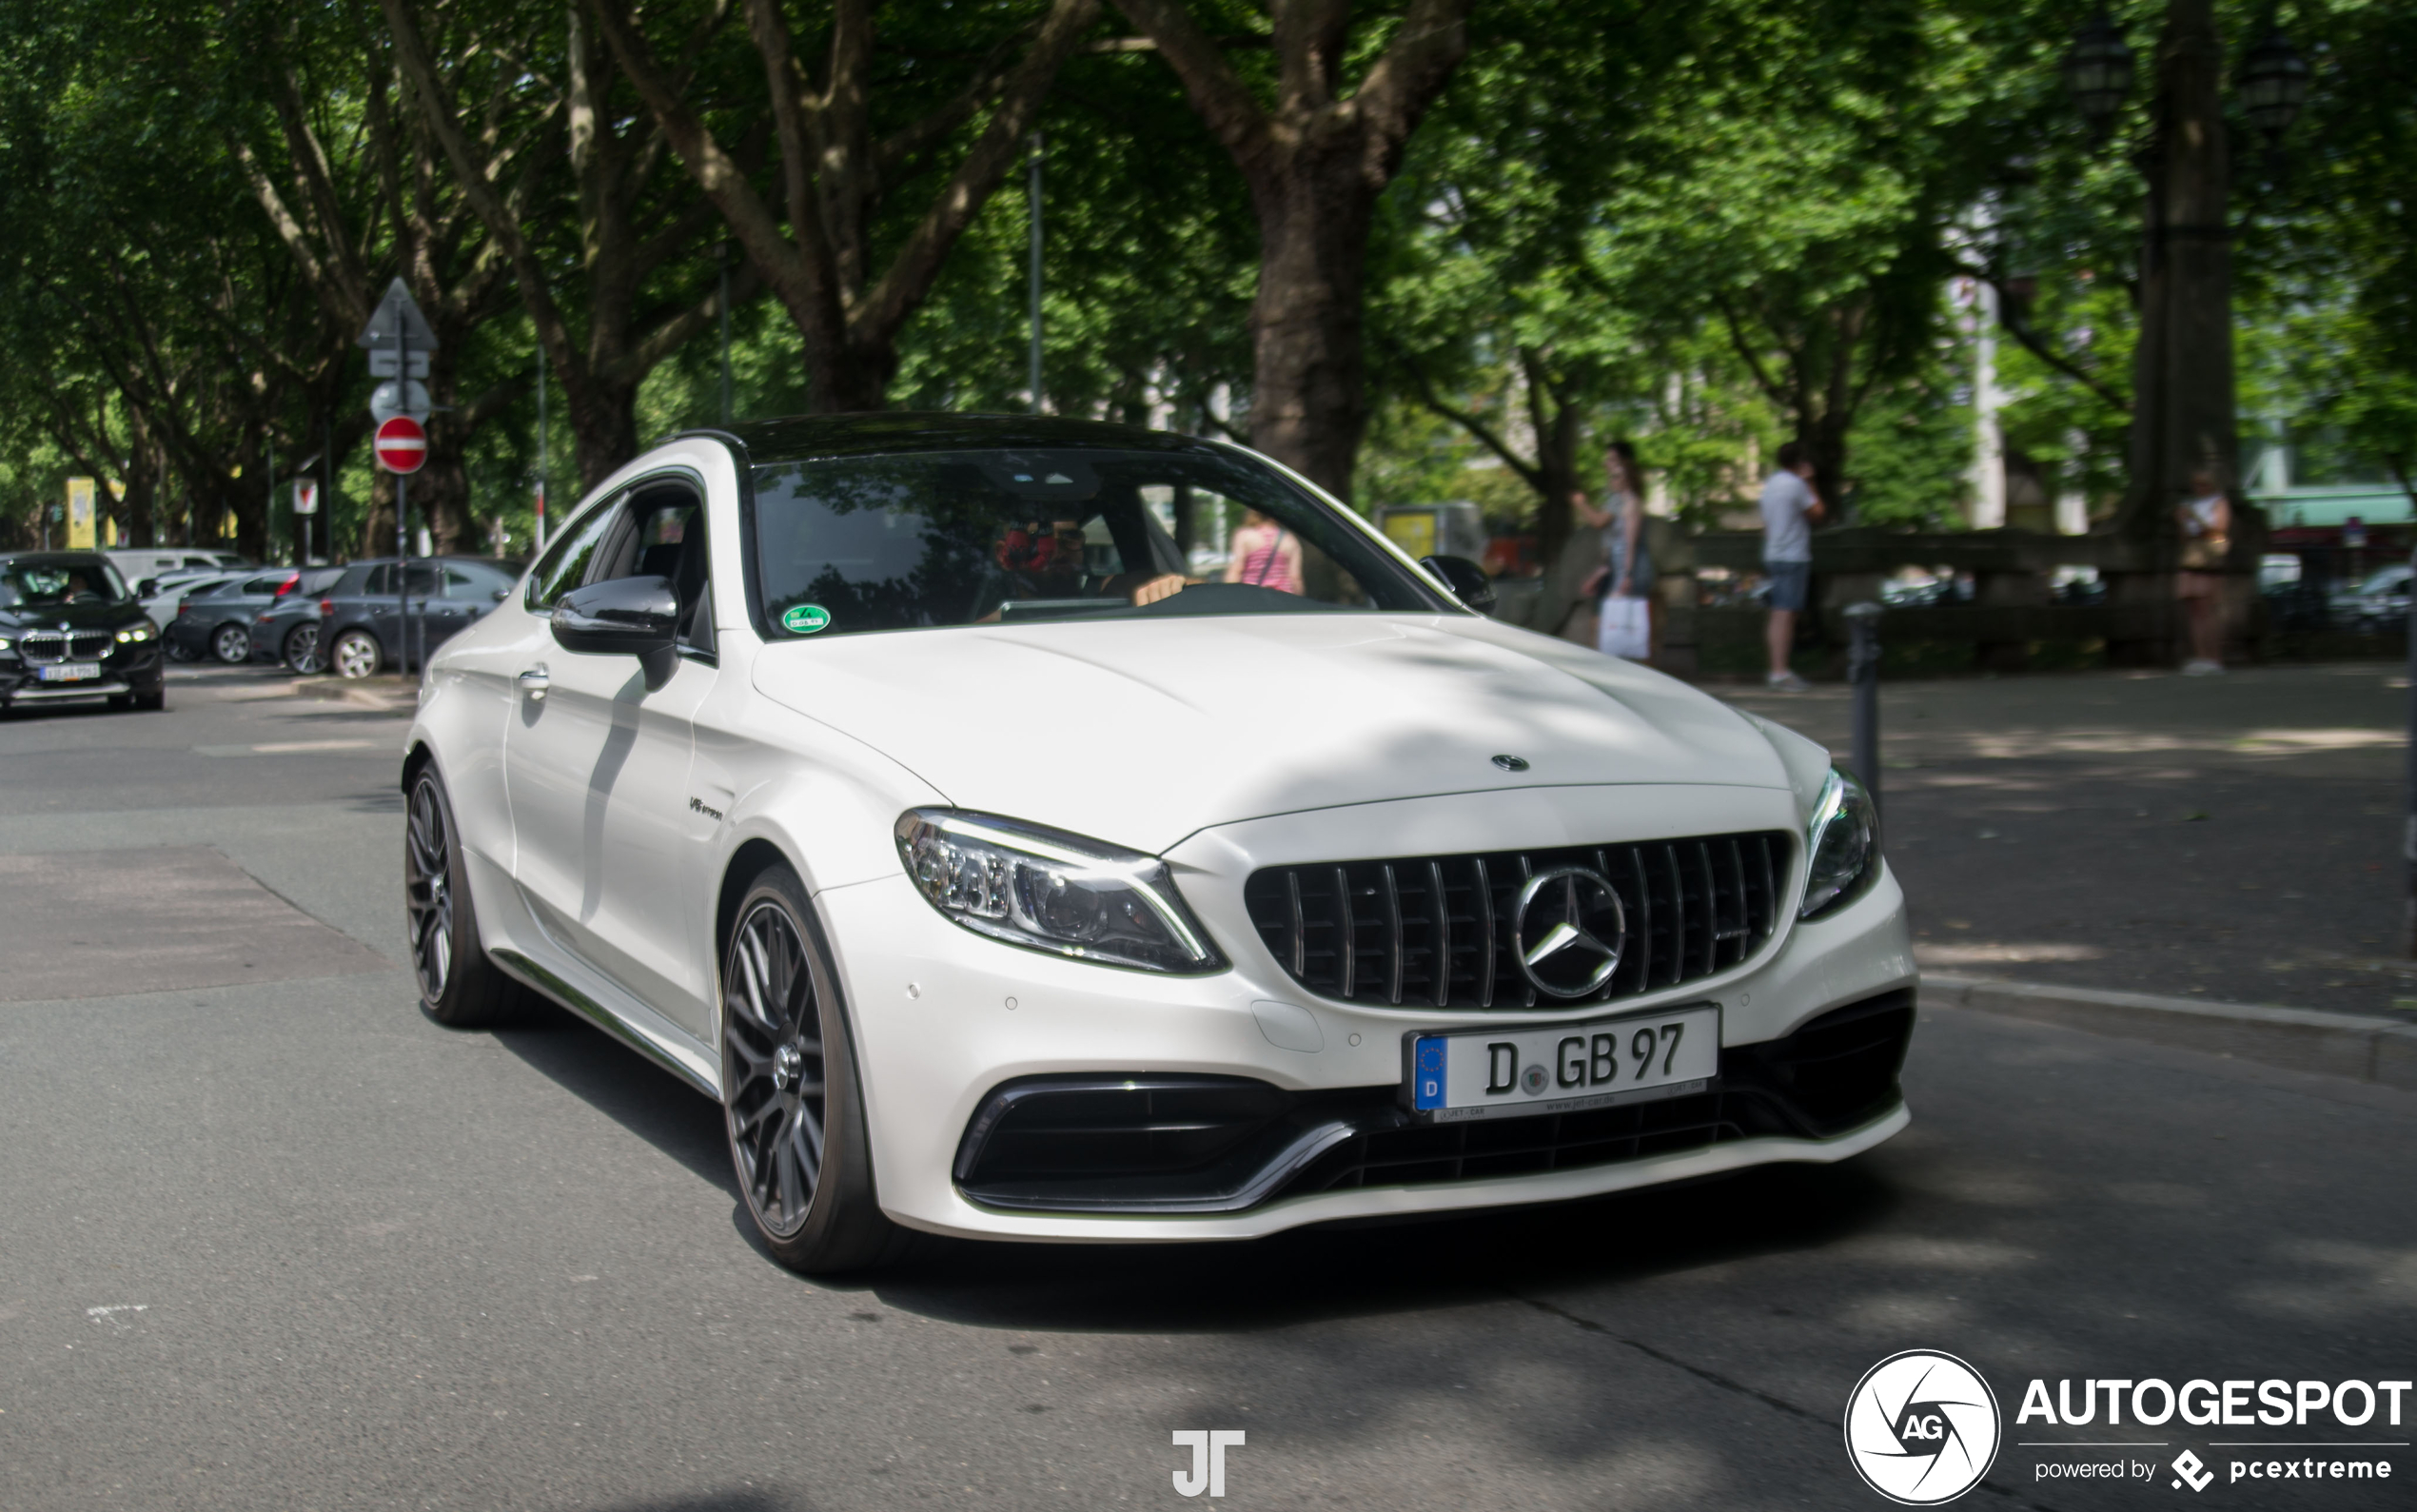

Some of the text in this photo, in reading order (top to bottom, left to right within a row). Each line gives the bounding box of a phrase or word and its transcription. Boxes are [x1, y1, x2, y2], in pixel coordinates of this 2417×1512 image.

[1485, 1022, 1685, 1095] D GB 97
[1426, 1081, 1438, 1097] D
